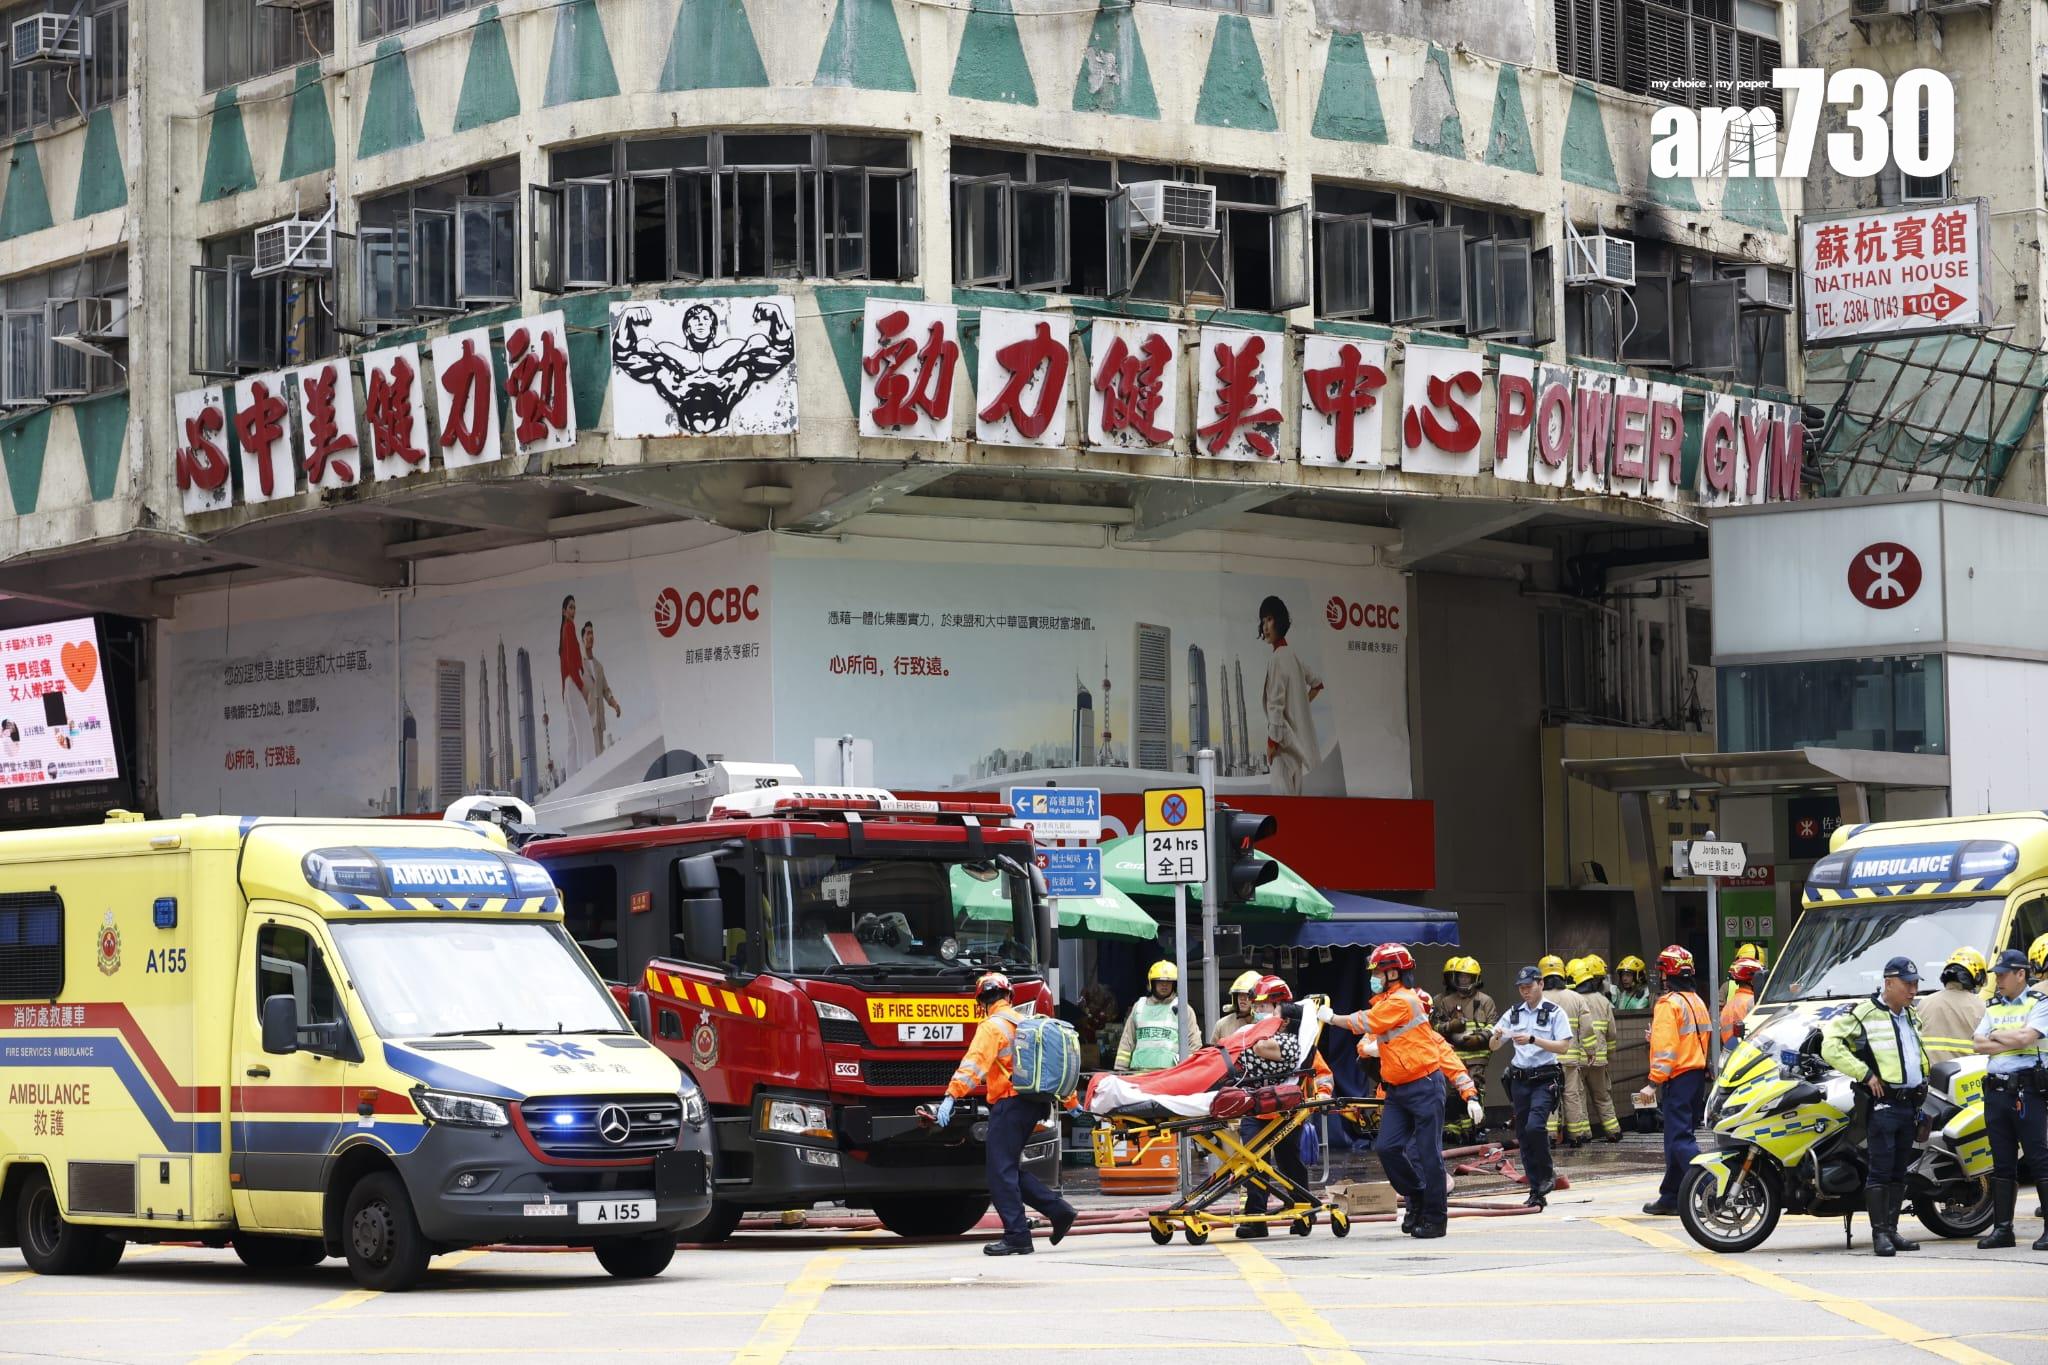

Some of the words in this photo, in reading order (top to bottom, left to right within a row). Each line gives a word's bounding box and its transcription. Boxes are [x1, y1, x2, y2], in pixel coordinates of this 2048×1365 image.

[1814, 209, 1969, 271] 蘇杭賓館
[1814, 268, 1892, 293] NATHAN
[1901, 259, 1969, 283] HOUSE
[1842, 301, 1870, 324] 2384
[1872, 296, 1899, 321] 0143
[1908, 292, 1951, 314] 10G
[1495, 374, 1683, 487] POWER
[1703, 411, 1803, 502] GYM
[685, 584, 760, 628] OCBC
[1349, 602, 1400, 630] OCBC
[685, 642, 760, 665] 前稱華僑永亨銀行
[5, 658, 52, 681] 再見經痛
[829, 655, 951, 677] 心所向，行致遠。
[224, 745, 301, 771] 心所向，行致遠。
[896, 801, 921, 809] FIRE
[1049, 795, 1085, 807] 高速鐵路
[1152, 837, 1173, 852] 24
[1176, 837, 1198, 851] hrs
[1702, 845, 1720, 856] Jordan
[1720, 845, 1734, 856] Road
[392, 863, 508, 886] AMBULANCE
[1157, 856, 1193, 876] 全日
[1851, 854, 1953, 880] AMBULANCE
[145, 948, 187, 974] A155
[13, 1005, 86, 1028] 消防處救護車
[872, 1002, 885, 1019] 消
[888, 1003, 914, 1018] FIRE
[916, 1003, 970, 1018] SERVICES
[907, 1026, 917, 1040] F
[922, 1025, 954, 1040] 2617
[5, 1047, 20, 1057] FIRE
[20, 1047, 52, 1057] SERVICES
[54, 1046, 94, 1057] AMBULANCE
[8, 1083, 91, 1106] AMBULANCE
[33, 1109, 65, 1137] 救護
[597, 1204, 608, 1221] A
[615, 1203, 640, 1220] 155
